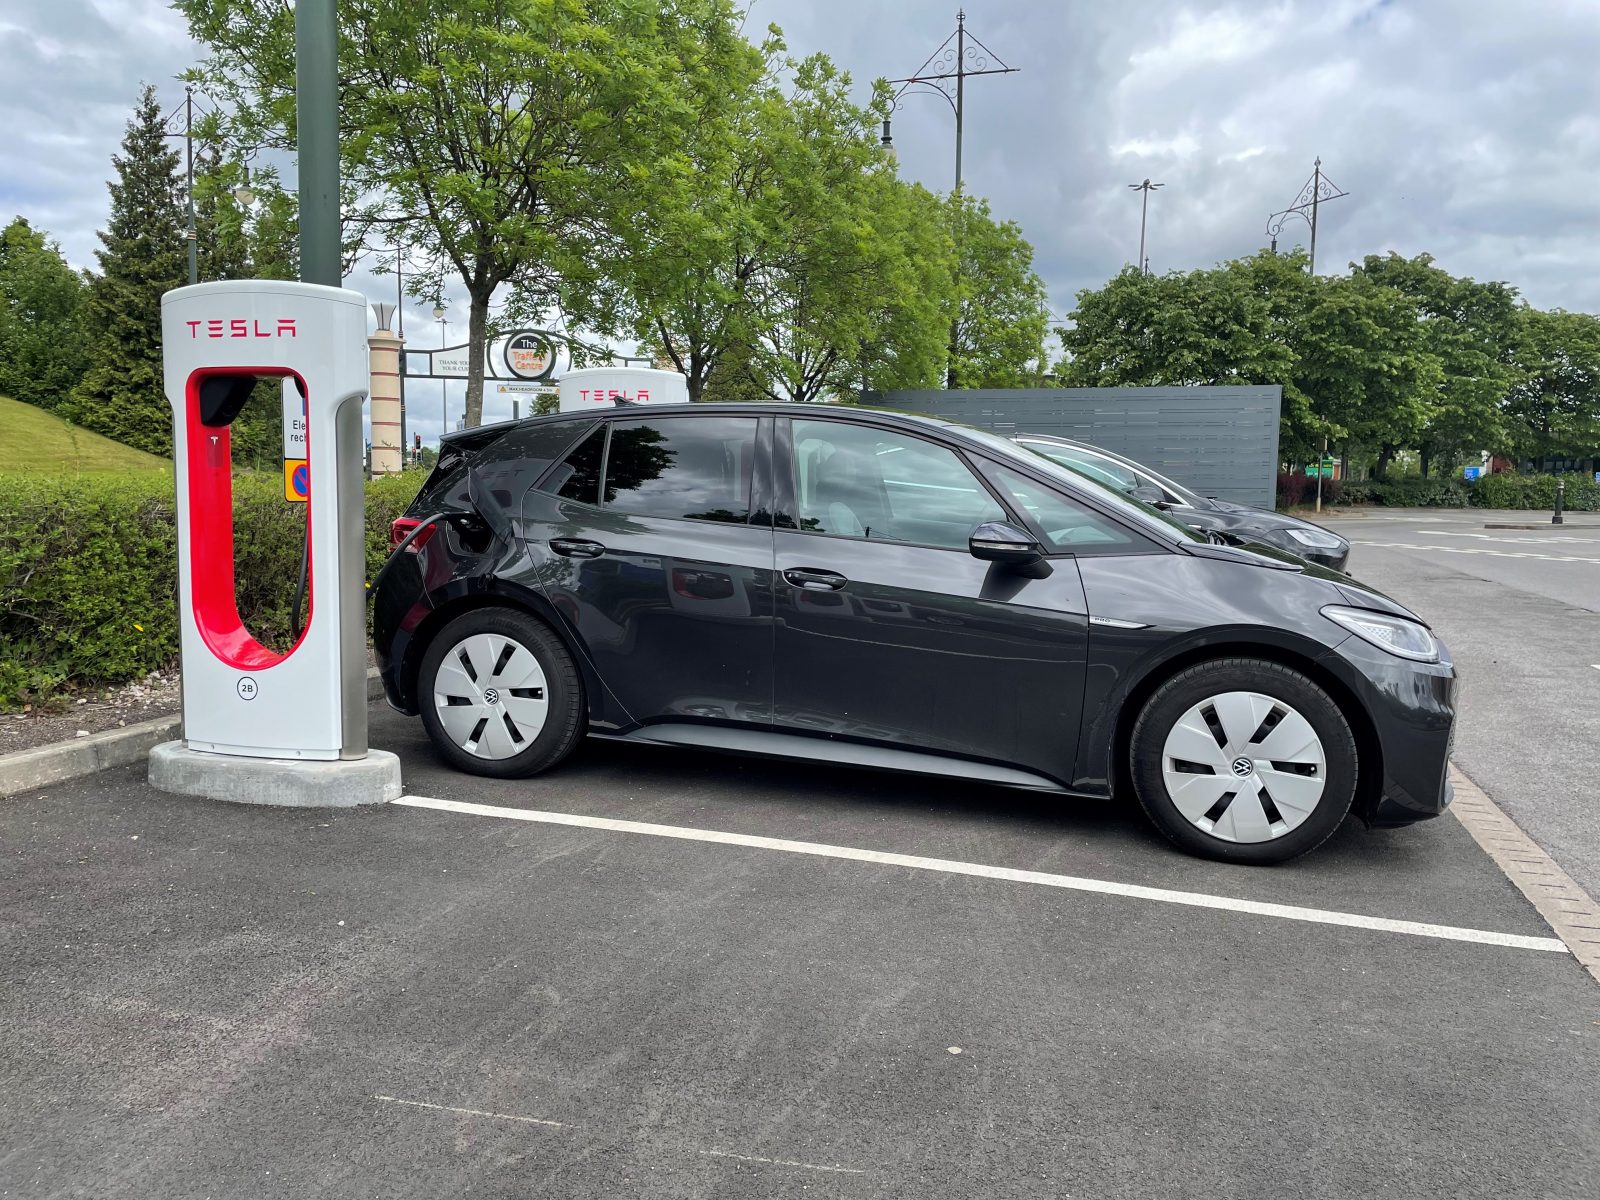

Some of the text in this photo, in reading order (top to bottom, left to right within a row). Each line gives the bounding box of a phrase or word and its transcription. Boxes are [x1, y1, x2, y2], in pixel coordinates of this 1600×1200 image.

[186, 319, 297, 339] TESLA
[520, 339, 538, 349] The
[515, 360, 544, 370] Centre
[579, 390, 649, 401] TESLA
[292, 419, 306, 430] Ele
[241, 684, 254, 693] 2B
